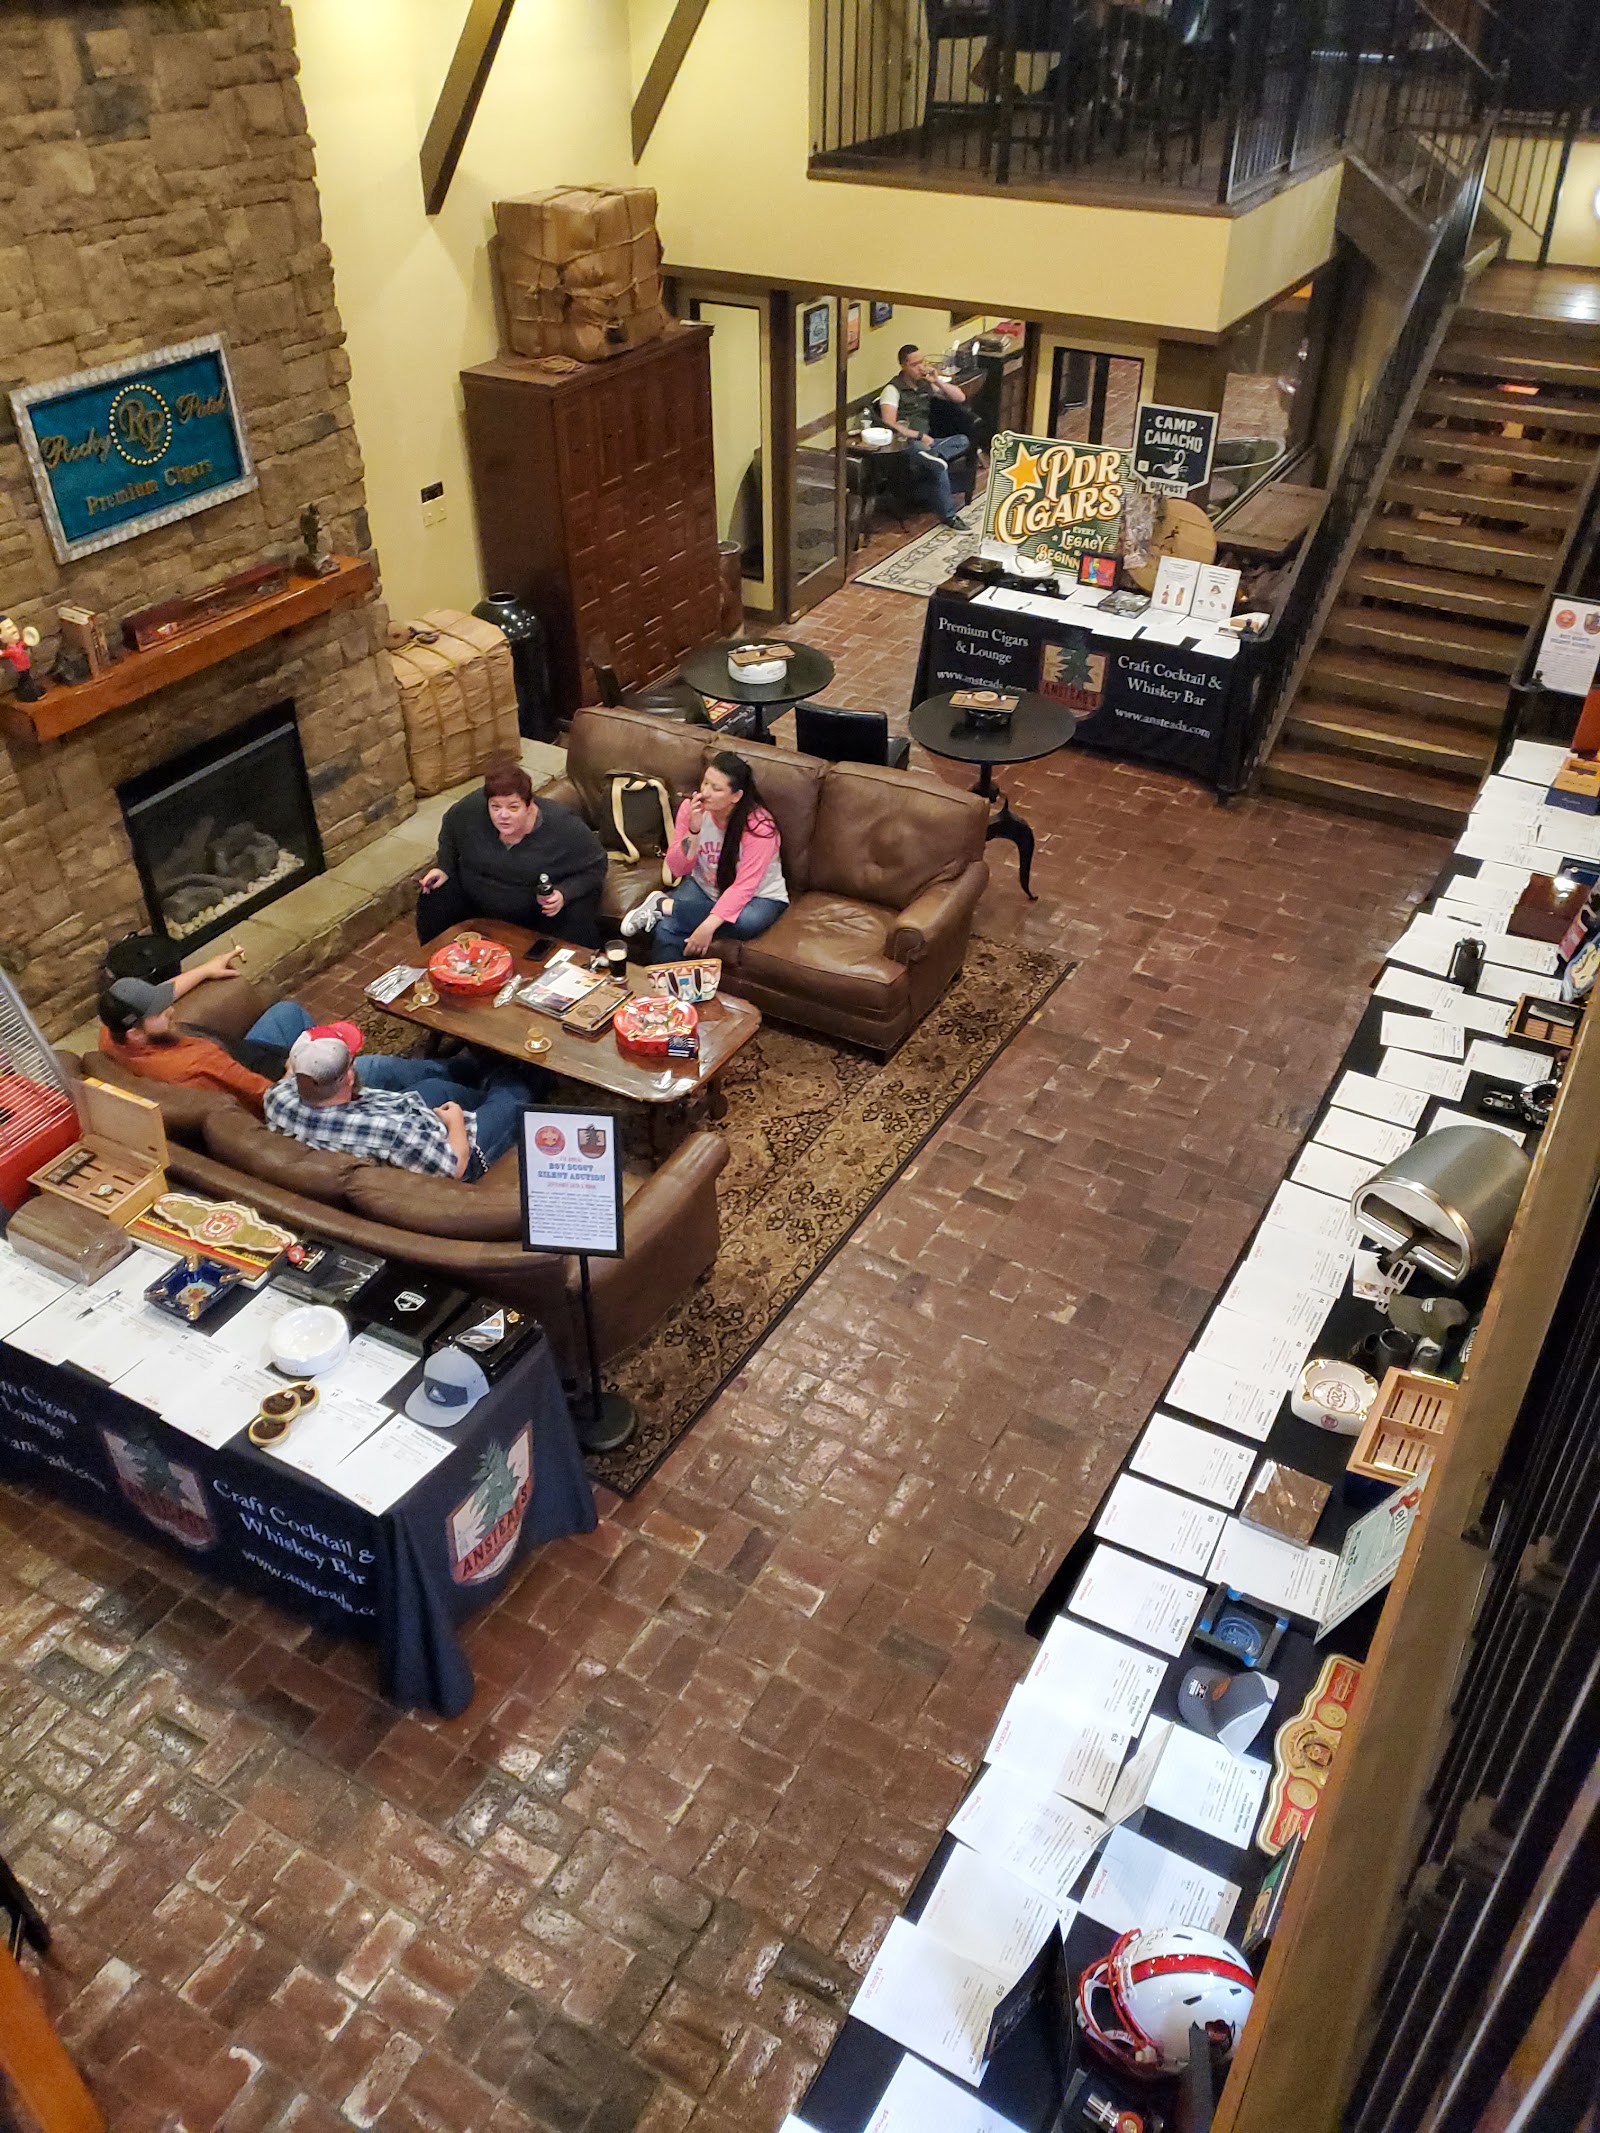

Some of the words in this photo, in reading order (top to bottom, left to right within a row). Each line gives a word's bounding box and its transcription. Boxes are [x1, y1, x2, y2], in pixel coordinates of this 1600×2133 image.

[1155, 416, 1197, 432] CAMP
[39, 427, 112, 469] Rocky
[1144, 429, 1203, 453] CAMACHO
[1037, 445, 1122, 502] PDR
[86, 479, 159, 515] Premium
[164, 460, 213, 486] Cigars
[995, 484, 1123, 544] CIGARS
[1059, 530, 1109, 552] LEGACY
[1073, 526, 1096, 535] EVERY
[1035, 544, 1080, 569] BEGINN
[938, 617, 989, 640] Premium
[992, 628, 1029, 648] Cigars
[955, 640, 967, 653] &
[969, 643, 1013, 666] Lounge
[1118, 655, 1151, 674] Craft
[1154, 663, 1206, 687] Cocktail
[1208, 674, 1223, 690] &
[1127, 677, 1181, 706] Whiskey
[1183, 691, 1206, 706] Bar
[1115, 708, 1211, 739] www.ansteads.com
[537, 1170, 567, 1179] SILENT
[569, 1172, 605, 1181] AUCTION
[548, 1162, 565, 1170] BOY
[567, 1163, 593, 1171] SCOUT
[213, 1479, 266, 1516] Craft
[269, 1506, 352, 1559] Cocktail
[359, 1550, 375, 1564] &
[239, 1512, 323, 1569] Whiskey
[331, 1558, 366, 1585] Bar
[242, 1550, 377, 1616] www.ansteads.c
[1110, 1732, 1118, 1742] 65
[1082, 1824, 1092, 1835] 41
[994, 1983, 1005, 1997] 59
